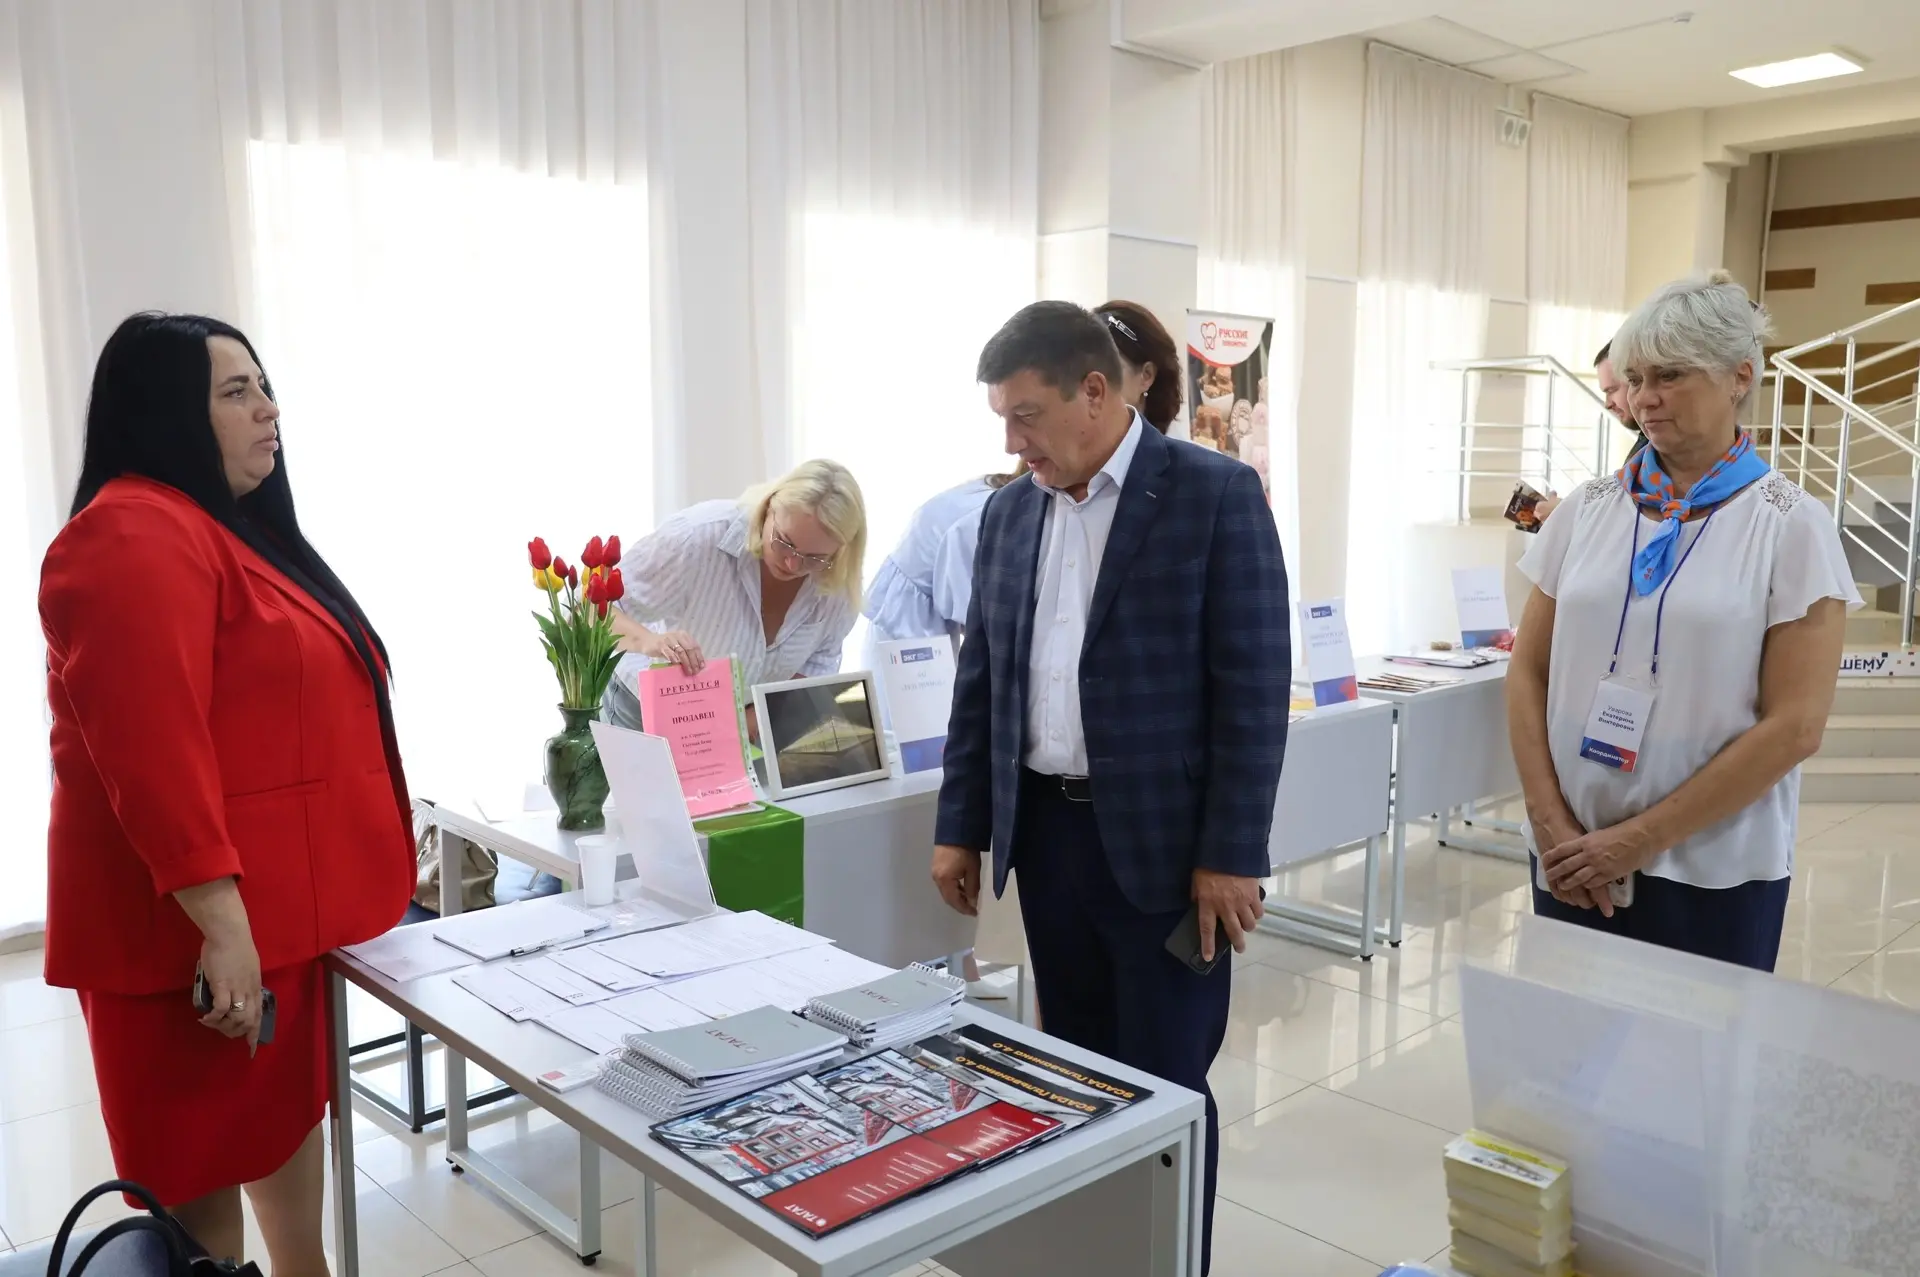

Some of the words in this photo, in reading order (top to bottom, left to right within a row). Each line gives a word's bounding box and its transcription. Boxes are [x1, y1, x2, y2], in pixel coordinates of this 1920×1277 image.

[672, 711, 715, 724] ПРОДАВЕЦ
[1598, 716, 1635, 731] Викторовна
[1602, 710, 1634, 724] Екатерина
[1589, 747, 1629, 764] Координатор
[992, 1042, 1014, 1054] 4.0
[955, 1055, 977, 1067] 4.0
[1014, 1049, 1087, 1081] Гальваника
[976, 1063, 1050, 1097] Гальваника
[784, 1203, 816, 1223] ТАГАТ
